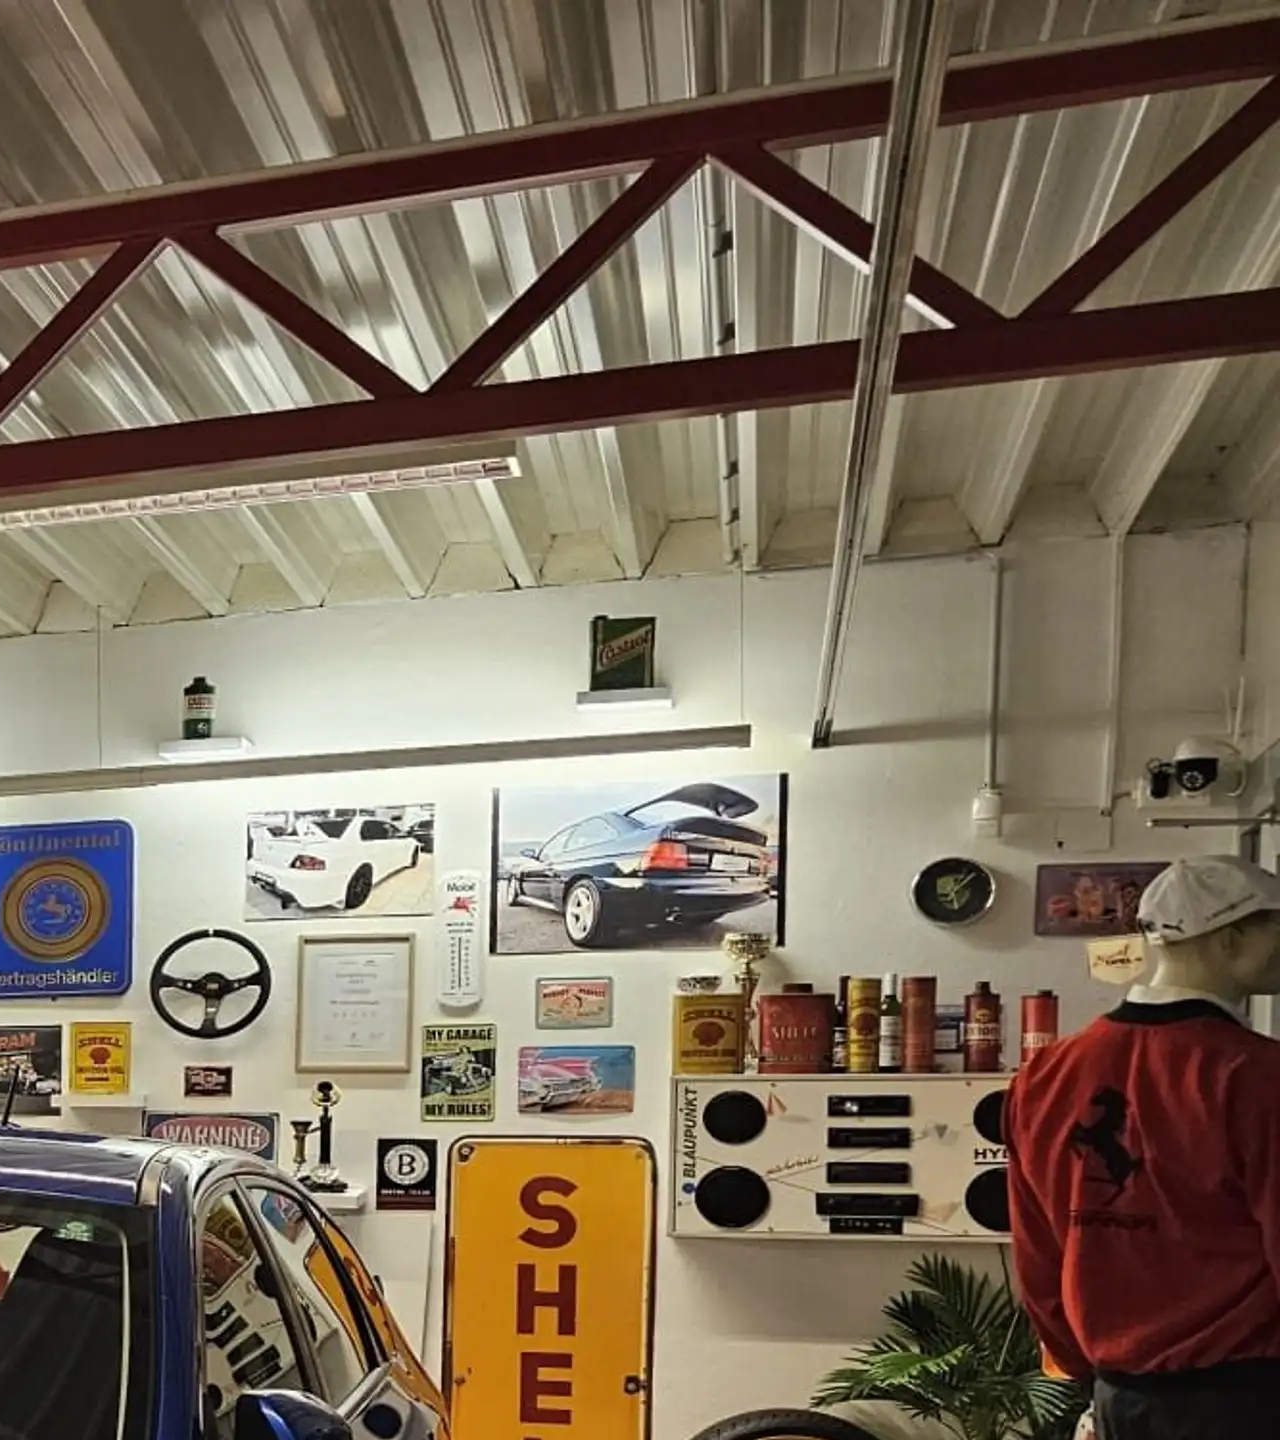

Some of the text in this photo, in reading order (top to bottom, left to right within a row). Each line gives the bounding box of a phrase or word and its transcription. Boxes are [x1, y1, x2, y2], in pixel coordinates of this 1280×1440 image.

[425, 1027, 494, 1041] MY GARAGE
[425, 1103, 444, 1116] MY
[161, 1124, 261, 1149] WARNING
[682, 1086, 698, 1179] BLAUPUNKT
[397, 1152, 416, 1177] B
